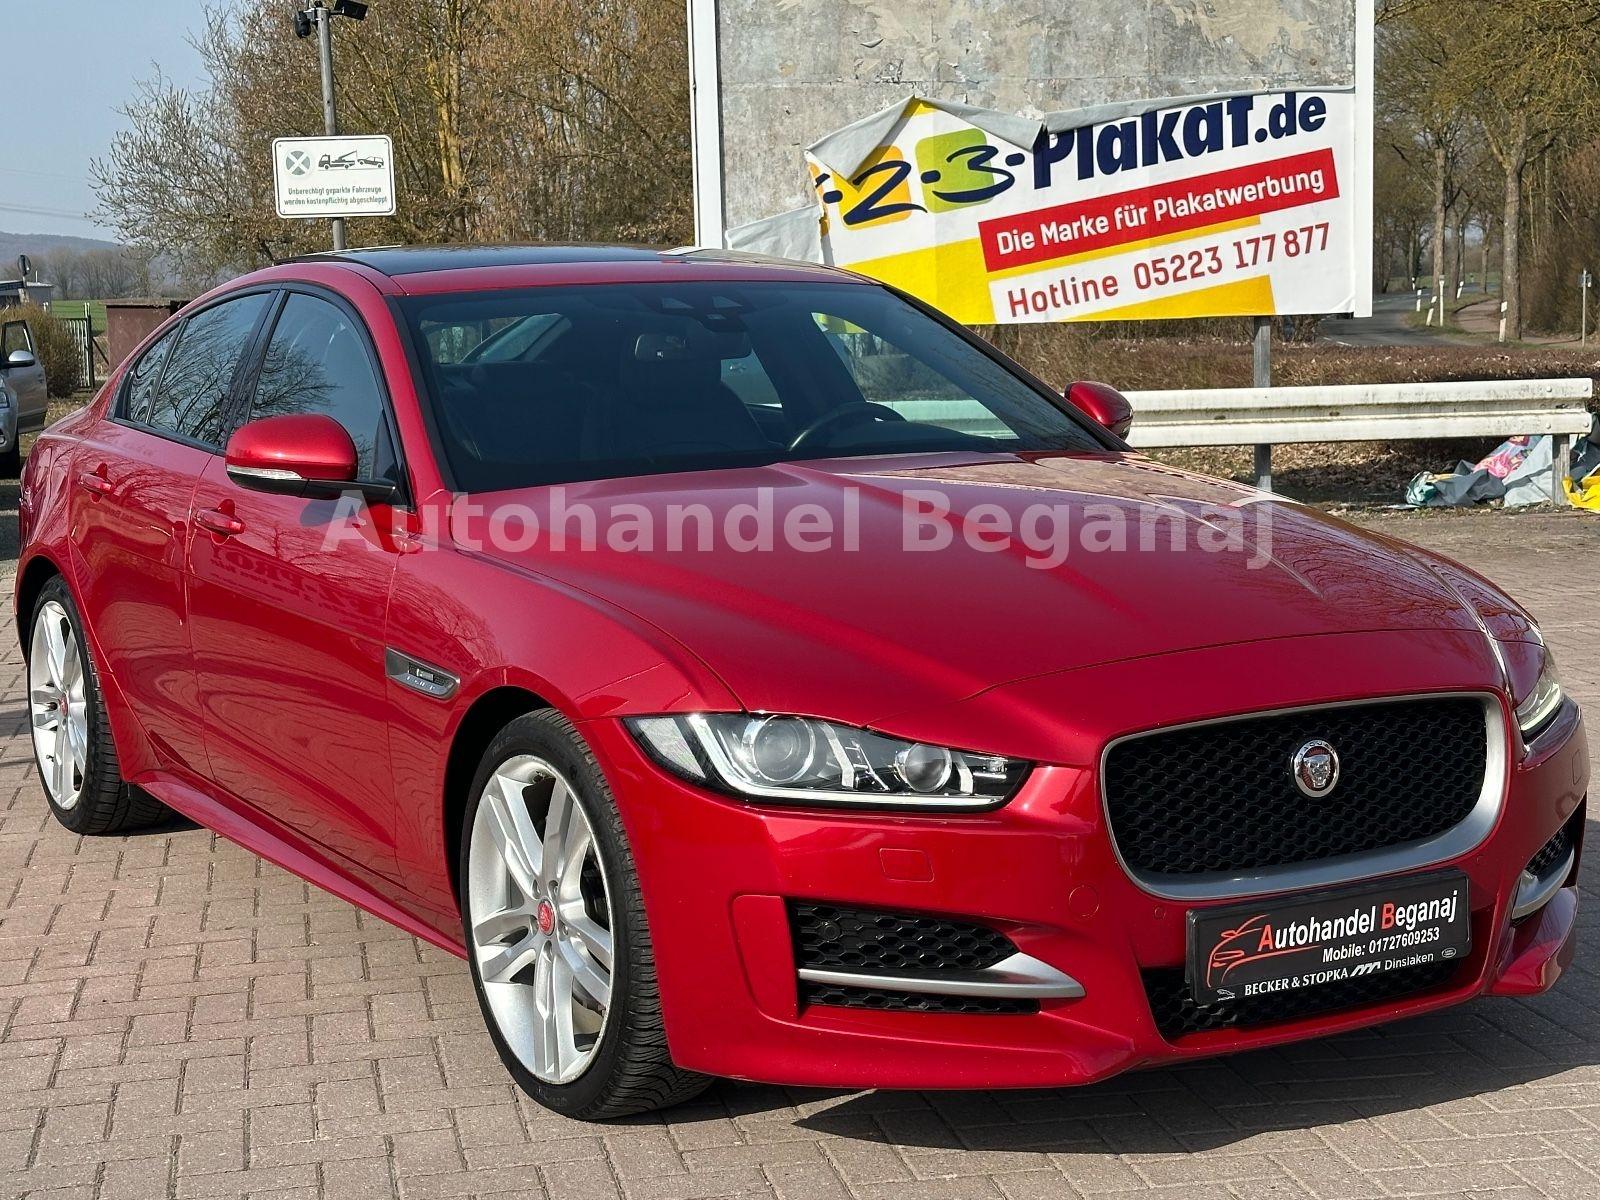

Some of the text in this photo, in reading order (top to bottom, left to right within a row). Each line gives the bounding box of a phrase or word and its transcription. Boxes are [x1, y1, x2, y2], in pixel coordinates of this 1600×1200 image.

[352, 185, 382, 194] Fahrzeuge
[996, 168, 1325, 255] Die Marke für Plakatwerbung
[1007, 222, 1330, 318] Hotline 05223 177 877
[1258, 890, 1458, 951] Autohandel Beganaj
[1322, 926, 1440, 963] Mobile: 01727609253
[1244, 952, 1434, 996] BECKER & STOPKA Dinslaken
